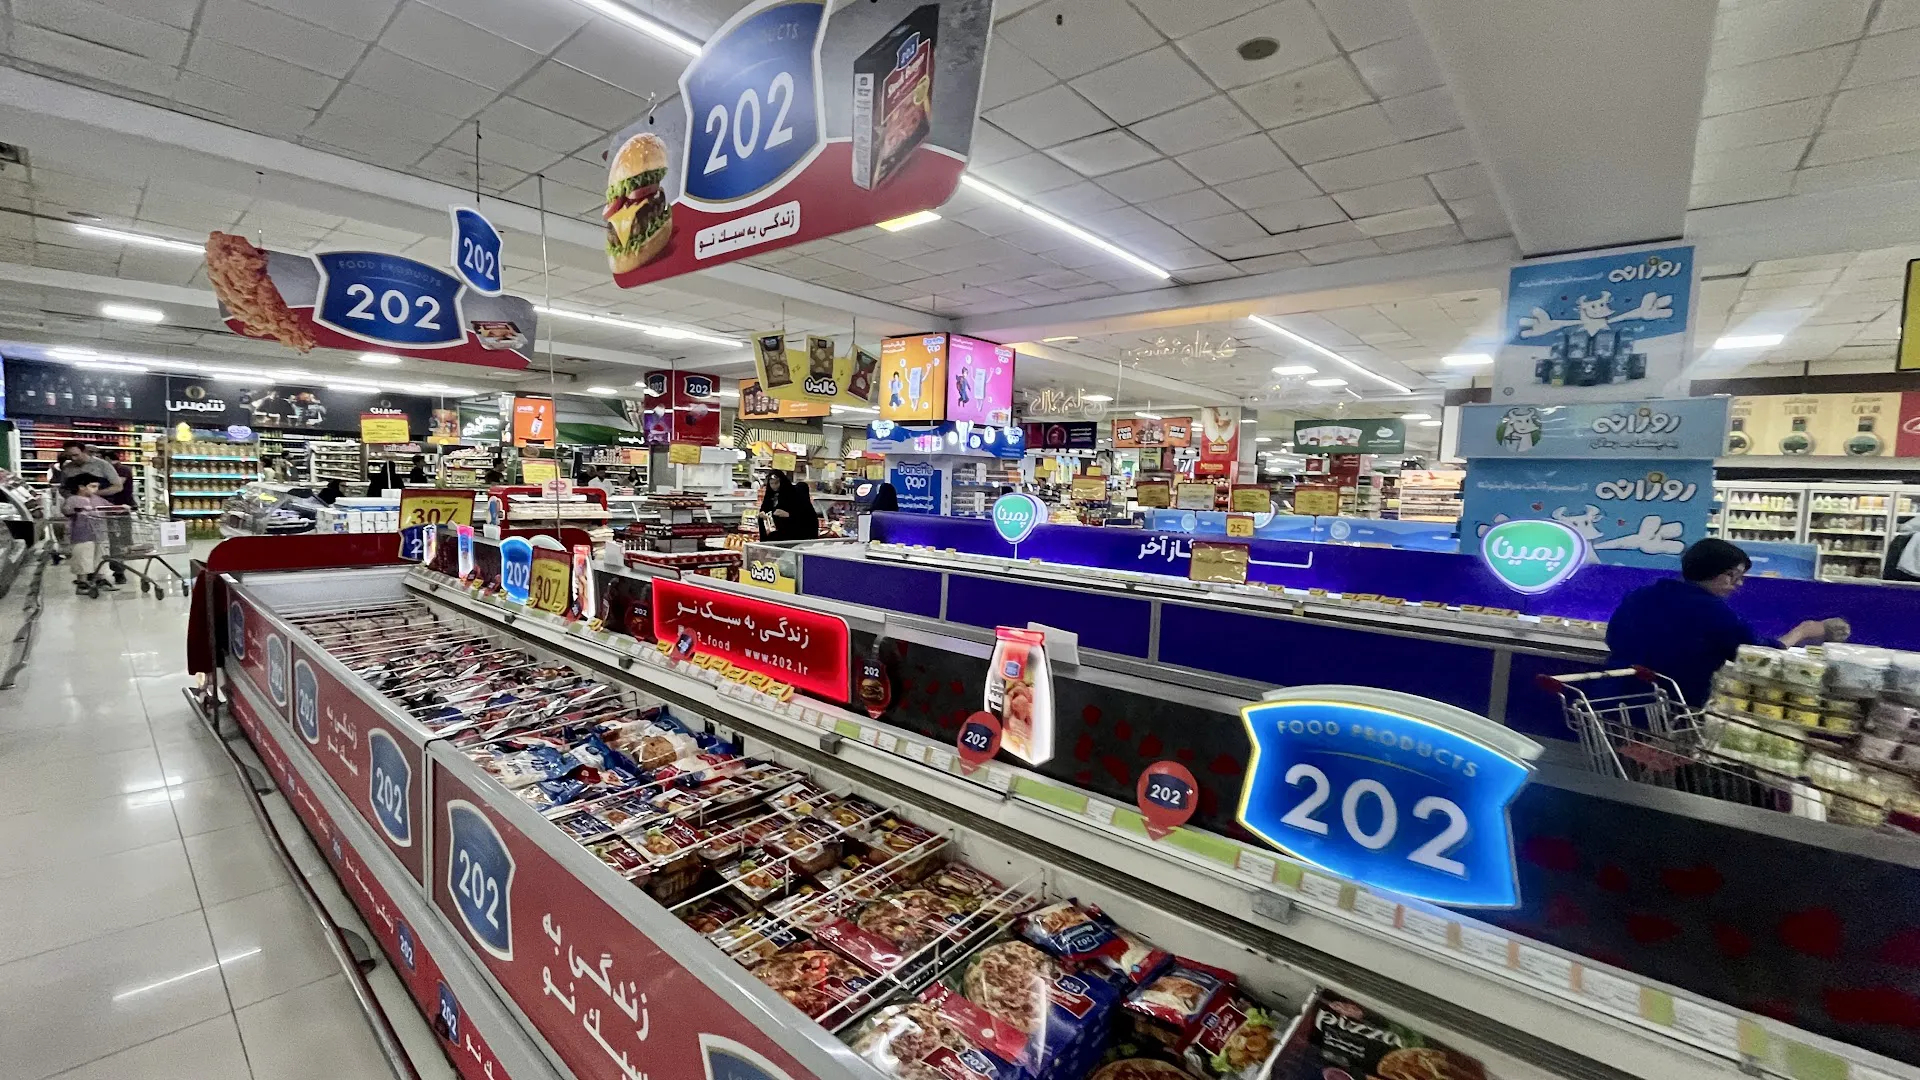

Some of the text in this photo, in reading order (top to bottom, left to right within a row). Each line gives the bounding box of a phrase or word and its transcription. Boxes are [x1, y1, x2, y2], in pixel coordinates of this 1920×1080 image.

[703, 71, 795, 175] 202
[746, 225, 757, 242] به
[759, 211, 795, 237] زندگی
[698, 234, 716, 252] نو
[338, 260, 375, 269] FOOD
[463, 236, 496, 281] 202
[1608, 256, 1682, 283] روزانه
[346, 283, 441, 330] 202
[689, 383, 708, 394] 202
[165, 399, 226, 412] شمس
[1591, 408, 1681, 434] روزانه
[899, 464, 933, 475] Danette
[1595, 471, 1698, 502] روزانه
[997, 505, 1029, 528] پمینا
[1138, 535, 1168, 560] آخر
[1167, 538, 1194, 562] از
[1493, 535, 1565, 572] پمینا
[506, 561, 530, 590] 202
[634, 606, 648, 617] 202
[677, 600, 809, 650] زندگی به سبک نو
[863, 665, 880, 678] 202
[300, 688, 315, 728] 202
[964, 730, 988, 750] 202
[1276, 720, 1478, 778] FOOD PRODUCTS
[376, 766, 403, 824] 202
[1150, 783, 1182, 806] 202
[1280, 763, 1470, 878] 202
[459, 849, 499, 930] 202
[400, 934, 414, 966] 202
[542, 913, 649, 1041] زندگی به
[542, 966, 576, 1015] نو
[441, 999, 457, 1036] 202
[963, 1054, 985, 1072] 202
